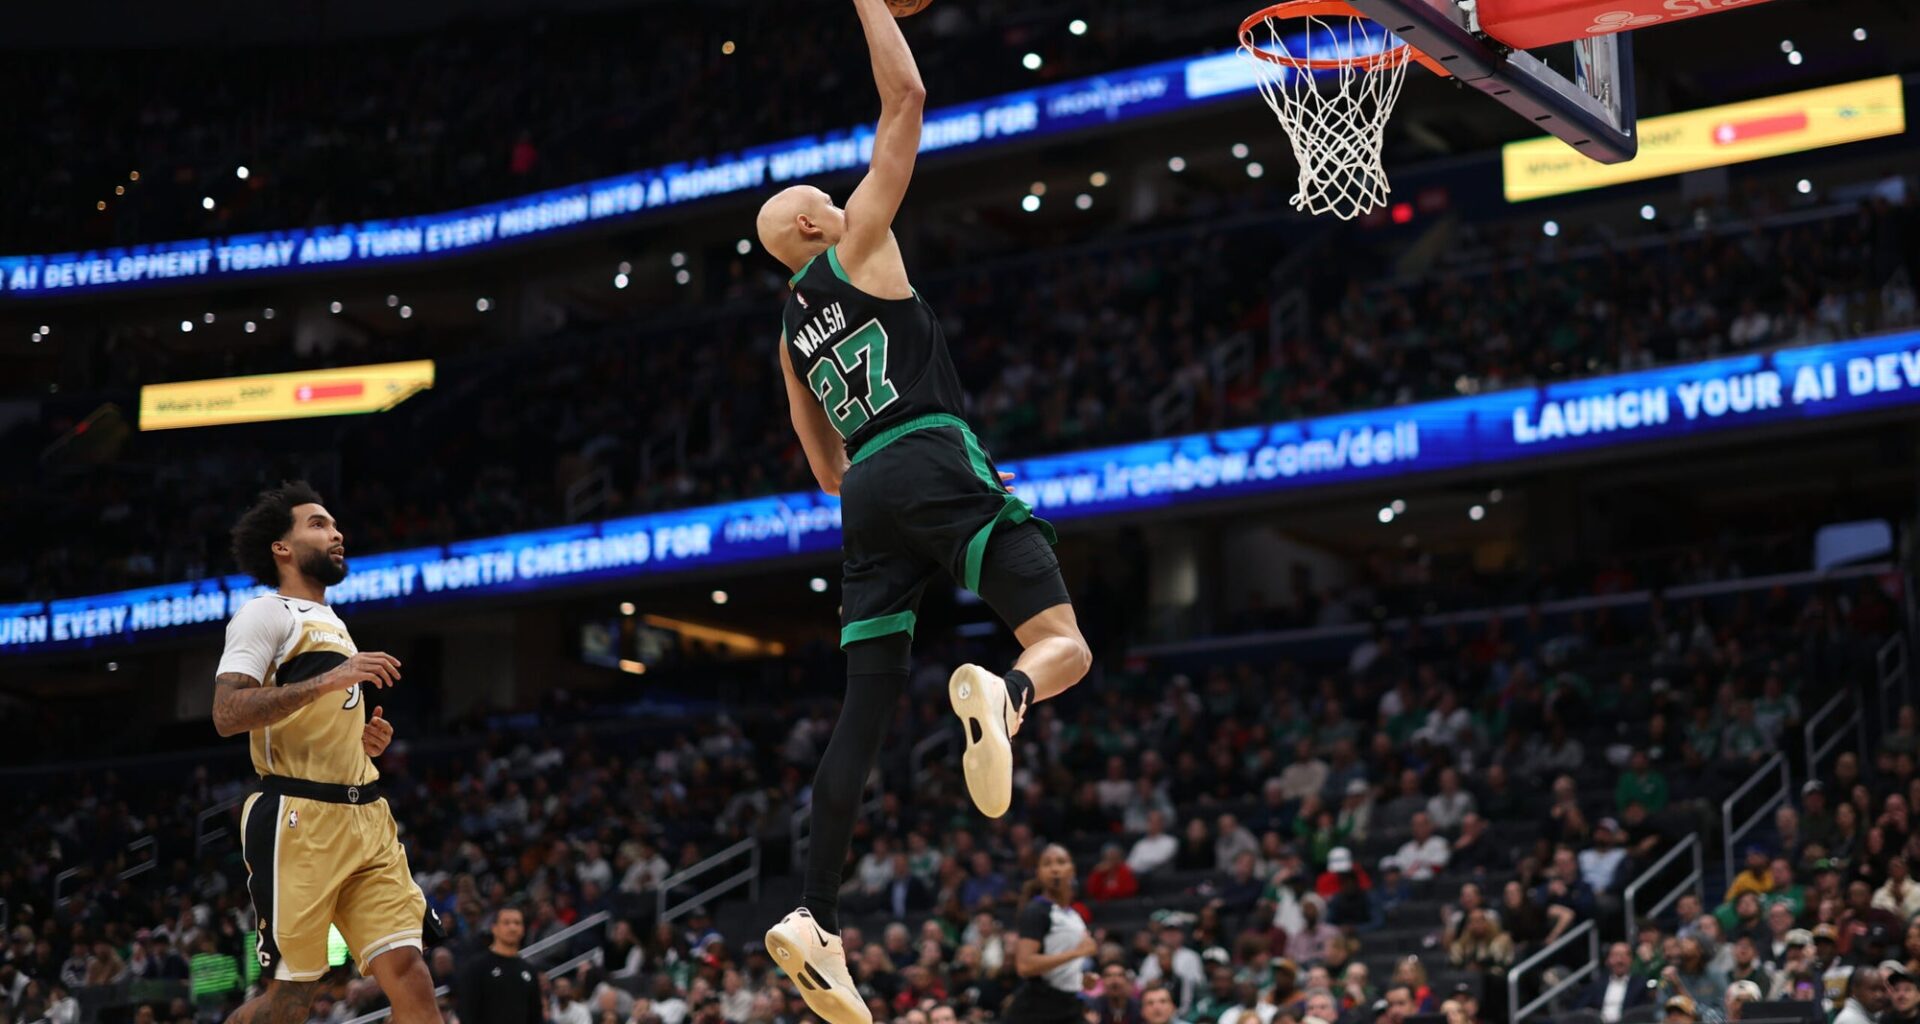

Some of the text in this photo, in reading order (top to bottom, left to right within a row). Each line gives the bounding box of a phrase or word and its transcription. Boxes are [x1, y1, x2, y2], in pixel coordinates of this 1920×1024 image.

[10, 265, 38, 290] AI
[44, 249, 212, 289] DEVELOPMENT
[217, 239, 295, 272] TODAY
[299, 233, 352, 265] AND
[356, 226, 422, 258] TURN
[425, 213, 497, 252] EVERY
[498, 194, 588, 238] MISSION
[589, 182, 645, 218] INTO
[646, 177, 667, 208] A
[984, 102, 1038, 138] FOR
[793, 302, 846, 358] WALSH
[807, 317, 899, 440] 27
[1513, 387, 1669, 443] LAUNCH
[1677, 370, 1782, 420] YOUR
[1793, 361, 1836, 405] AI
[52, 605, 128, 642] EVERY
[130, 590, 227, 632] MISSION
[421, 550, 513, 592] WORTH
[518, 532, 650, 577] CHEERING
[654, 523, 710, 559] FOR
